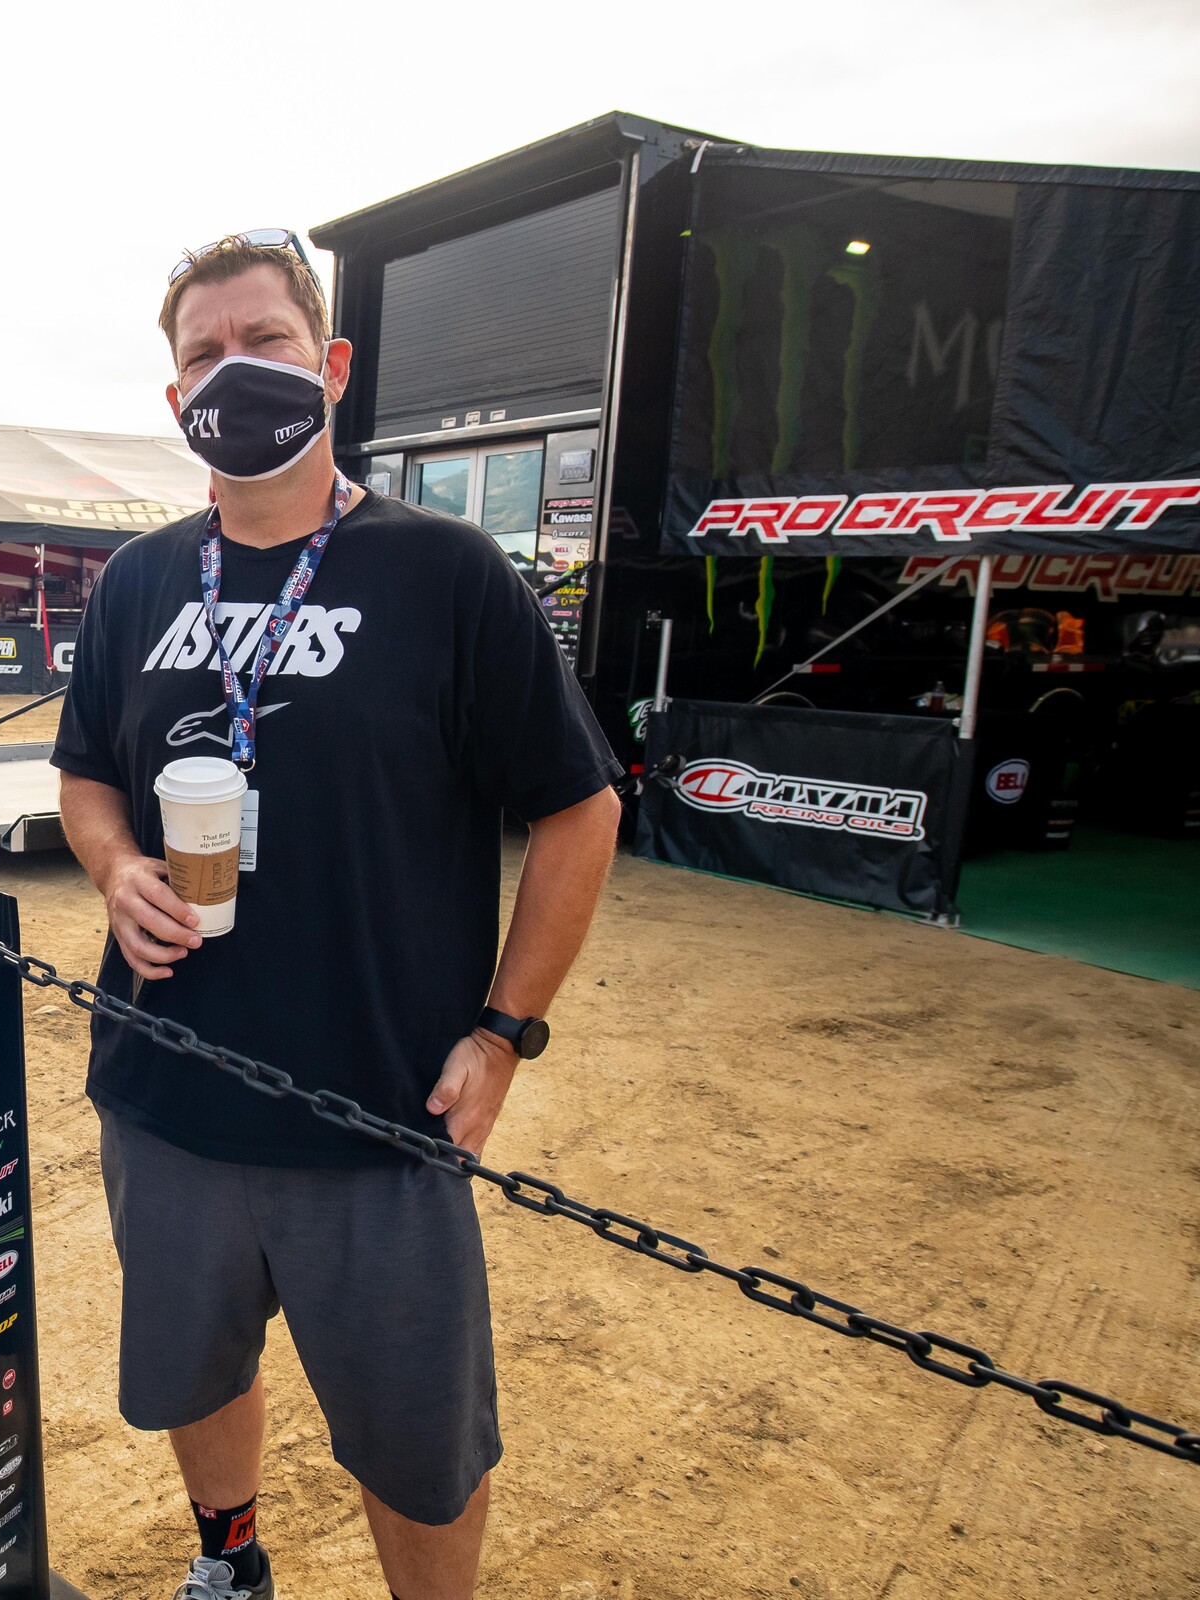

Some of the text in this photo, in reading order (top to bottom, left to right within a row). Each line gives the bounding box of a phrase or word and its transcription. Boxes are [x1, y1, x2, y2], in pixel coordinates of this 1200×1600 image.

[188, 408, 221, 438] FLY
[551, 512, 593, 524] Kawasa
[688, 478, 1200, 544] PRO CIRCUIT
[751, 802, 914, 834] RACING OILS
[201, 831, 231, 842] That first
